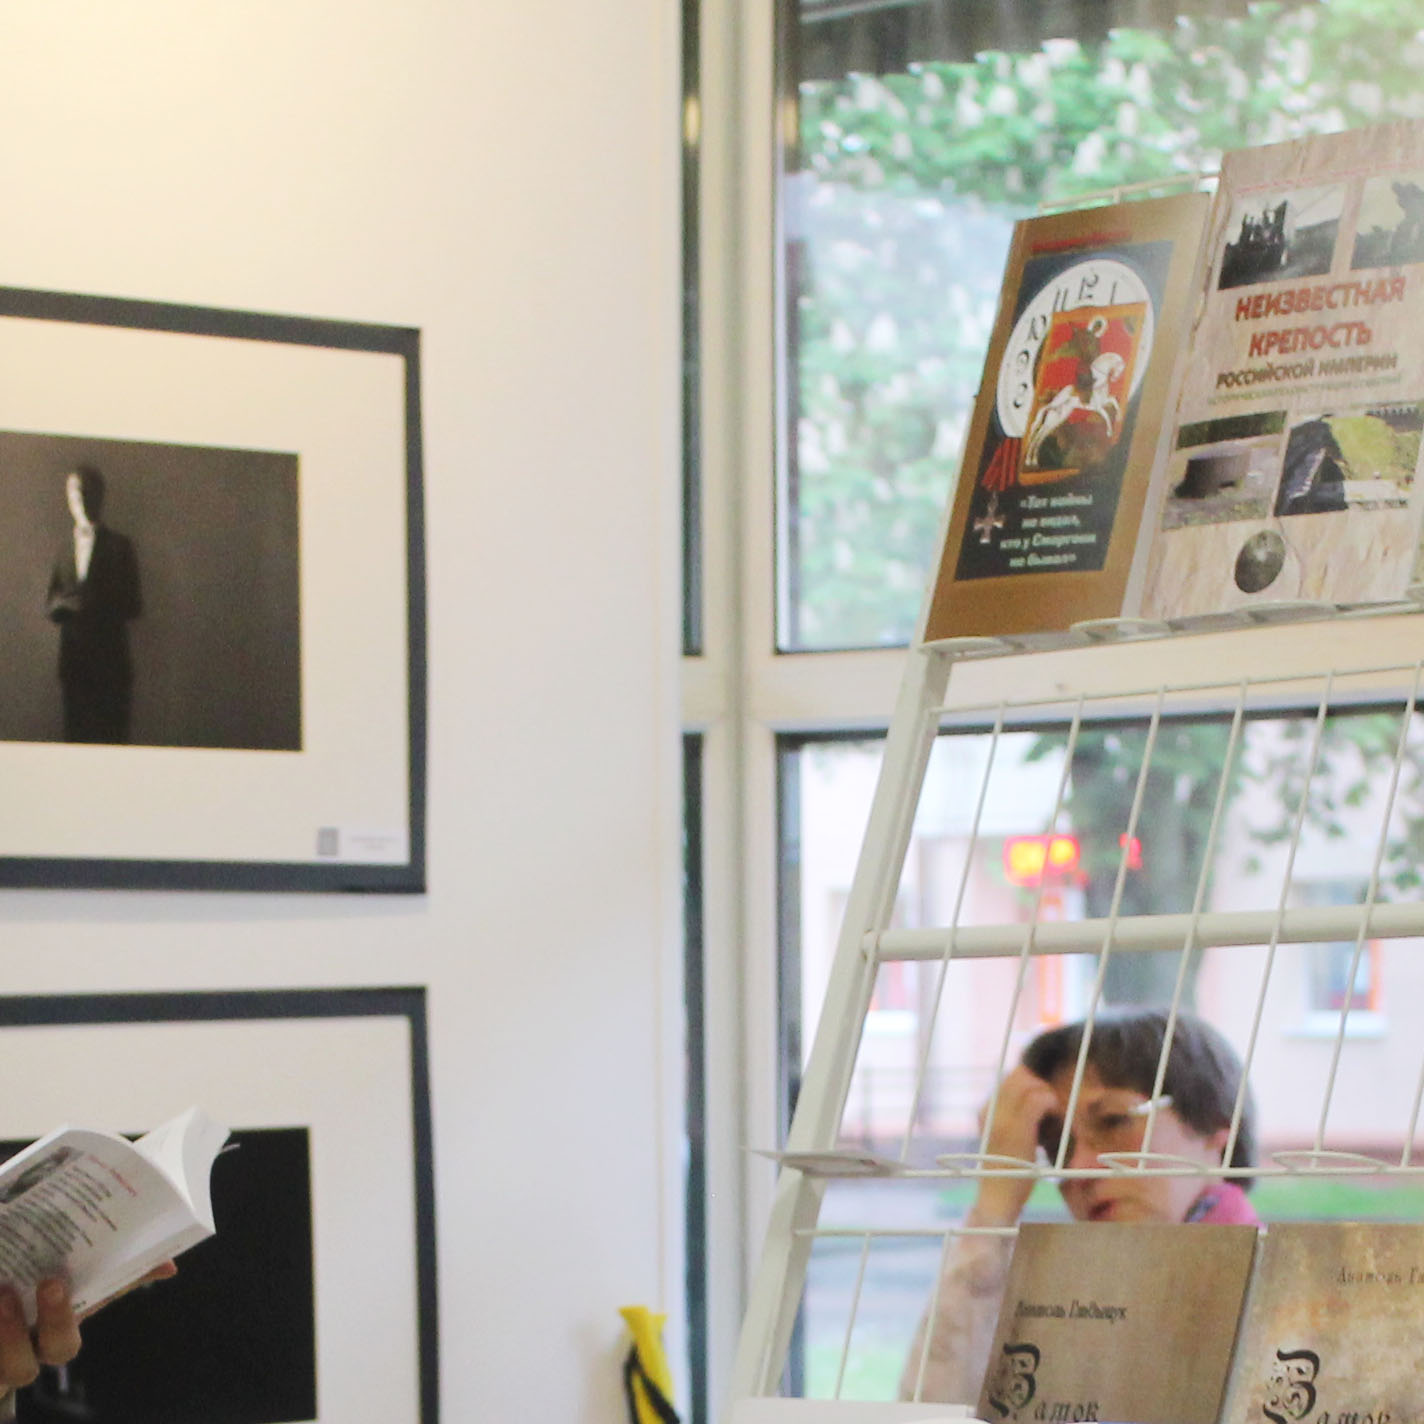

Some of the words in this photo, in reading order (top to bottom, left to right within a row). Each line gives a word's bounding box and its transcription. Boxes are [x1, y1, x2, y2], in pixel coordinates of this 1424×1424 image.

[1234, 276, 1406, 322] НЕИЗВЕСТНАЯ
[1248, 320, 1374, 358] КРЕПОСТЬ
[1216, 356, 1315, 390] РОССИЙСКОЙ
